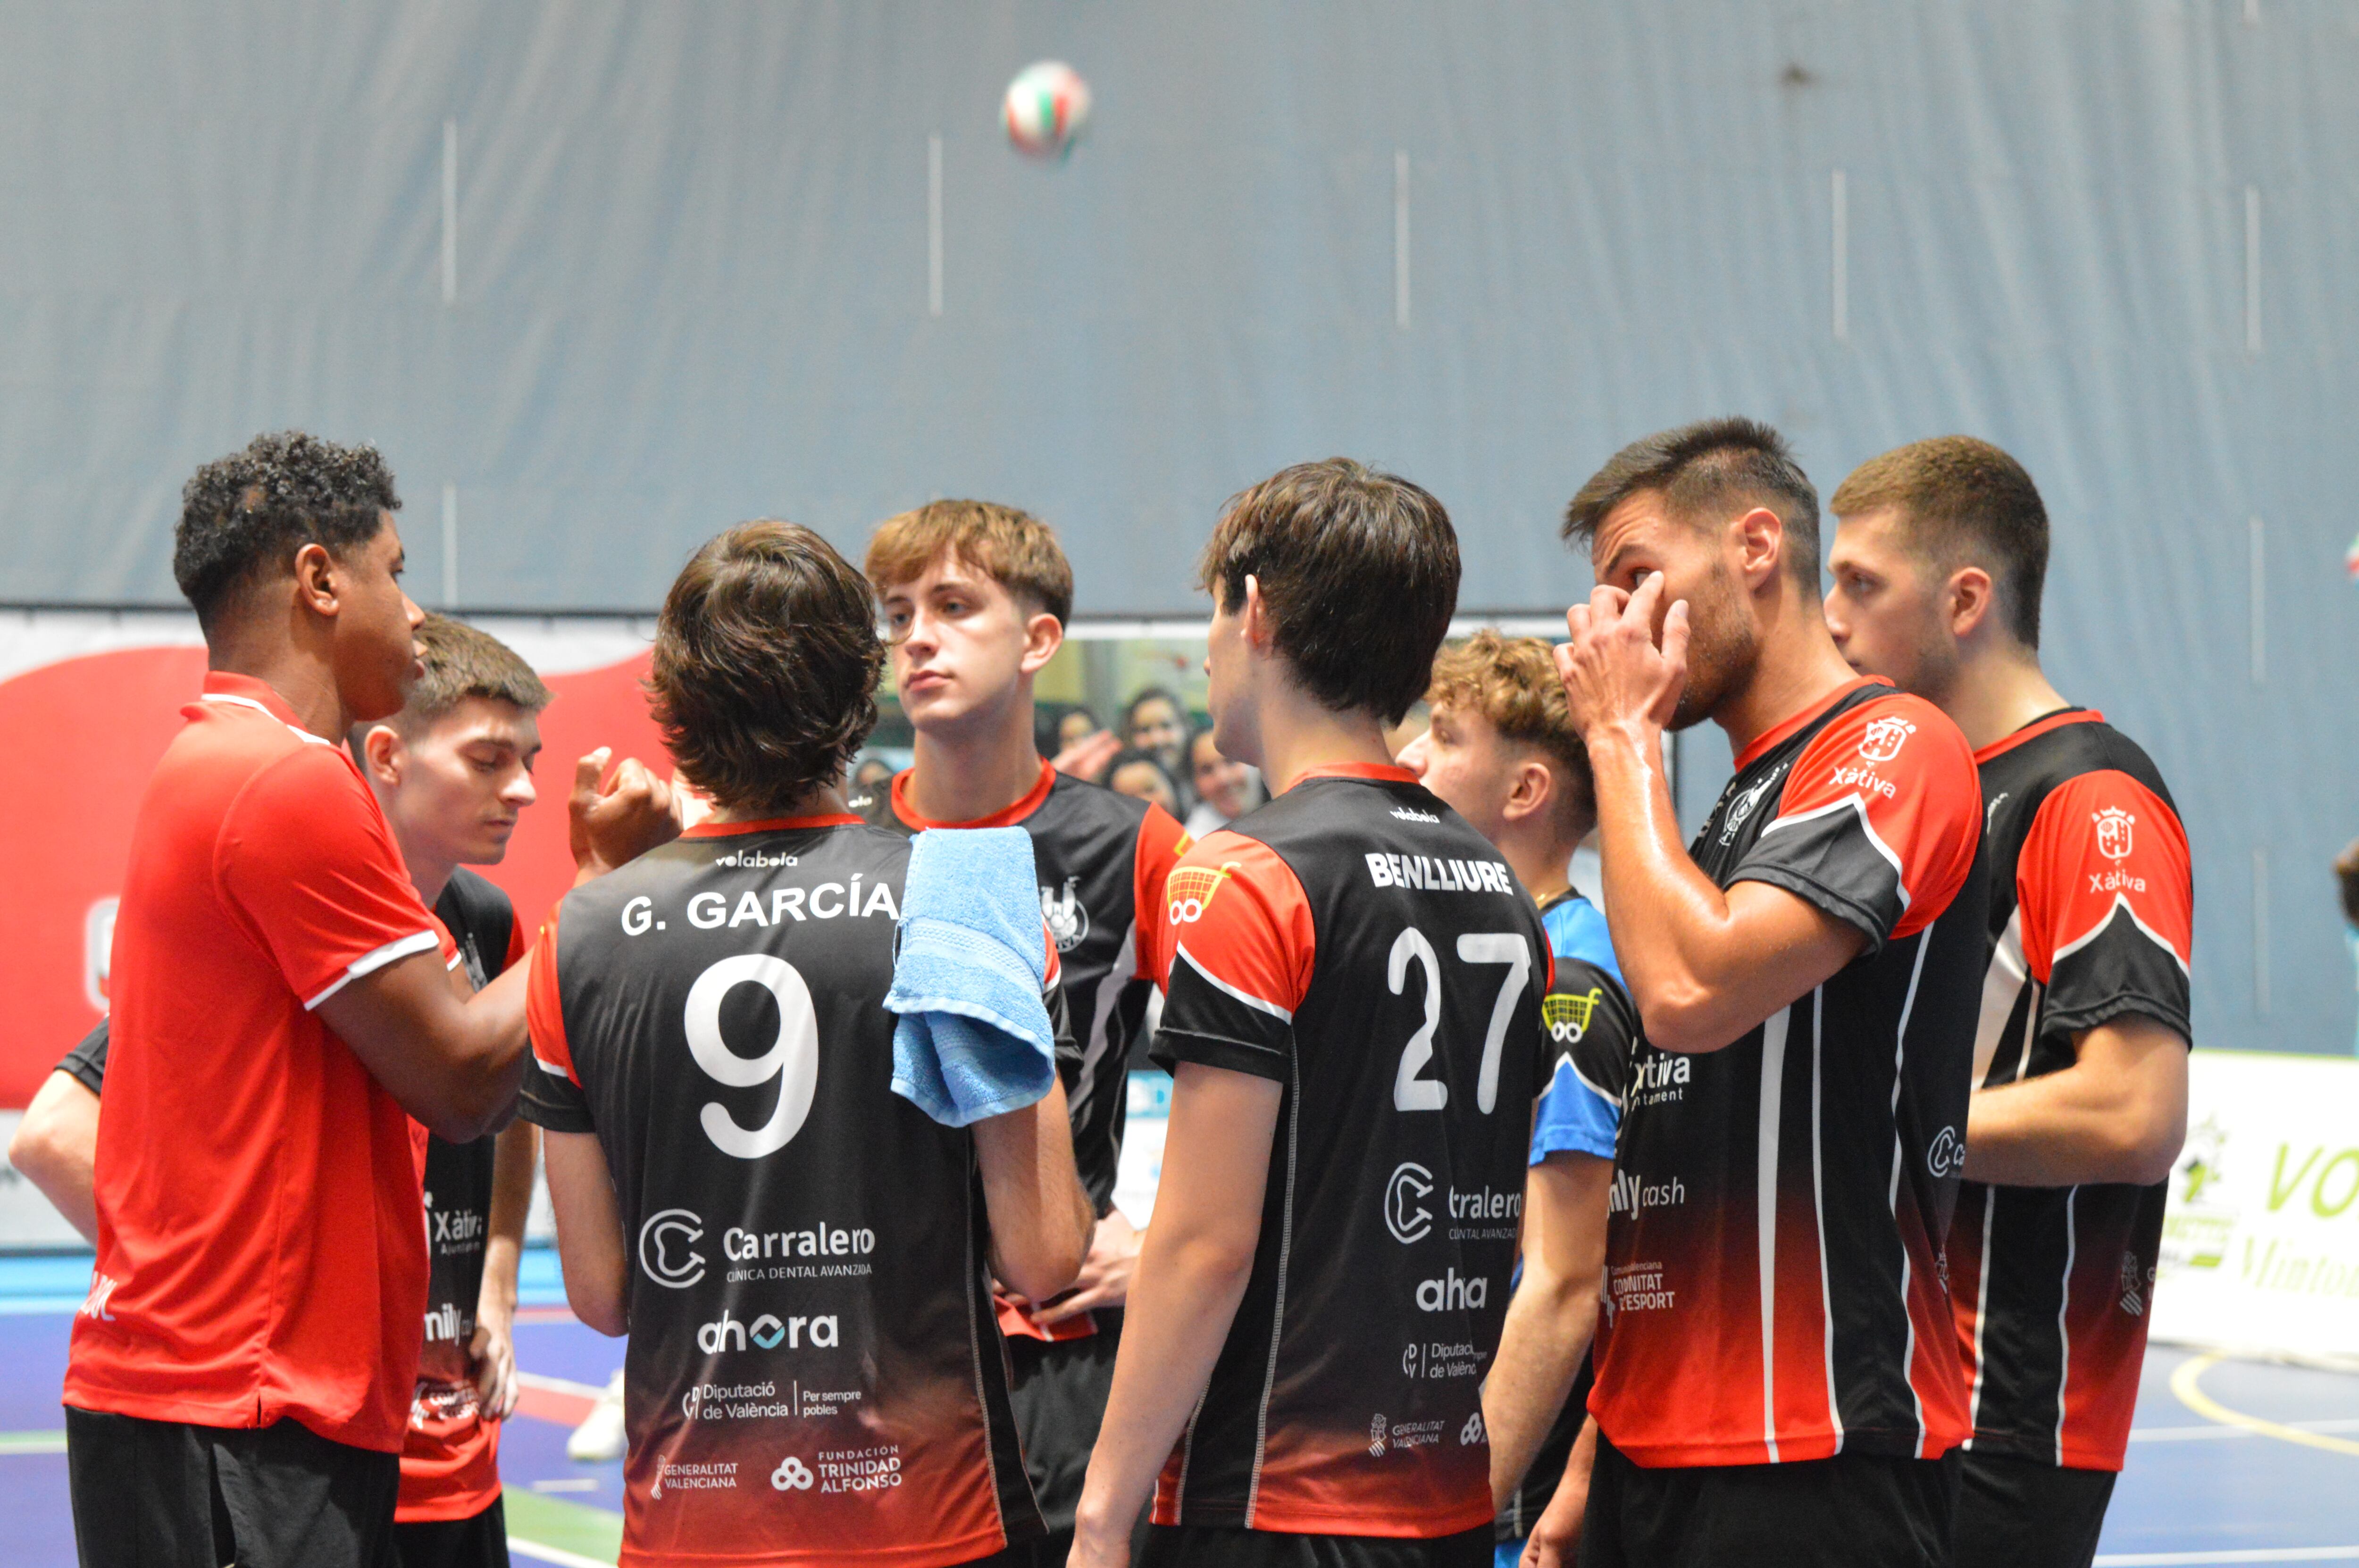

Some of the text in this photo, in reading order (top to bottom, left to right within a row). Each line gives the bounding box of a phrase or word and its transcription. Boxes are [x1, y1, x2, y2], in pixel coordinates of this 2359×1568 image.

[1829, 767, 1896, 799] Xàtiva
[716, 850, 798, 867] volabola
[1365, 853, 1514, 896] BENLLIURE
[2089, 868, 2145, 893] Xàtiva
[621, 873, 900, 936] G. GARCÍA
[1388, 926, 1531, 1115] 27
[684, 954, 819, 1159] 9
[724, 1221, 875, 1261] Carralero
[769, 1266, 818, 1280] DENTAL
[820, 1264, 872, 1277] AVANZADA
[697, 1309, 838, 1354] ahora
[703, 1381, 775, 1402] Diputació
[803, 1391, 820, 1402] Per
[822, 1390, 862, 1403] sempre
[703, 1406, 722, 1419] de
[726, 1402, 788, 1419] València
[803, 1405, 838, 1418] pobles
[818, 1445, 899, 1461] FUNDACIÓN
[664, 1457, 902, 1478] GENERALITAT TRINIDAD
[665, 1473, 902, 1493] VALENCIANA ALFONSO
